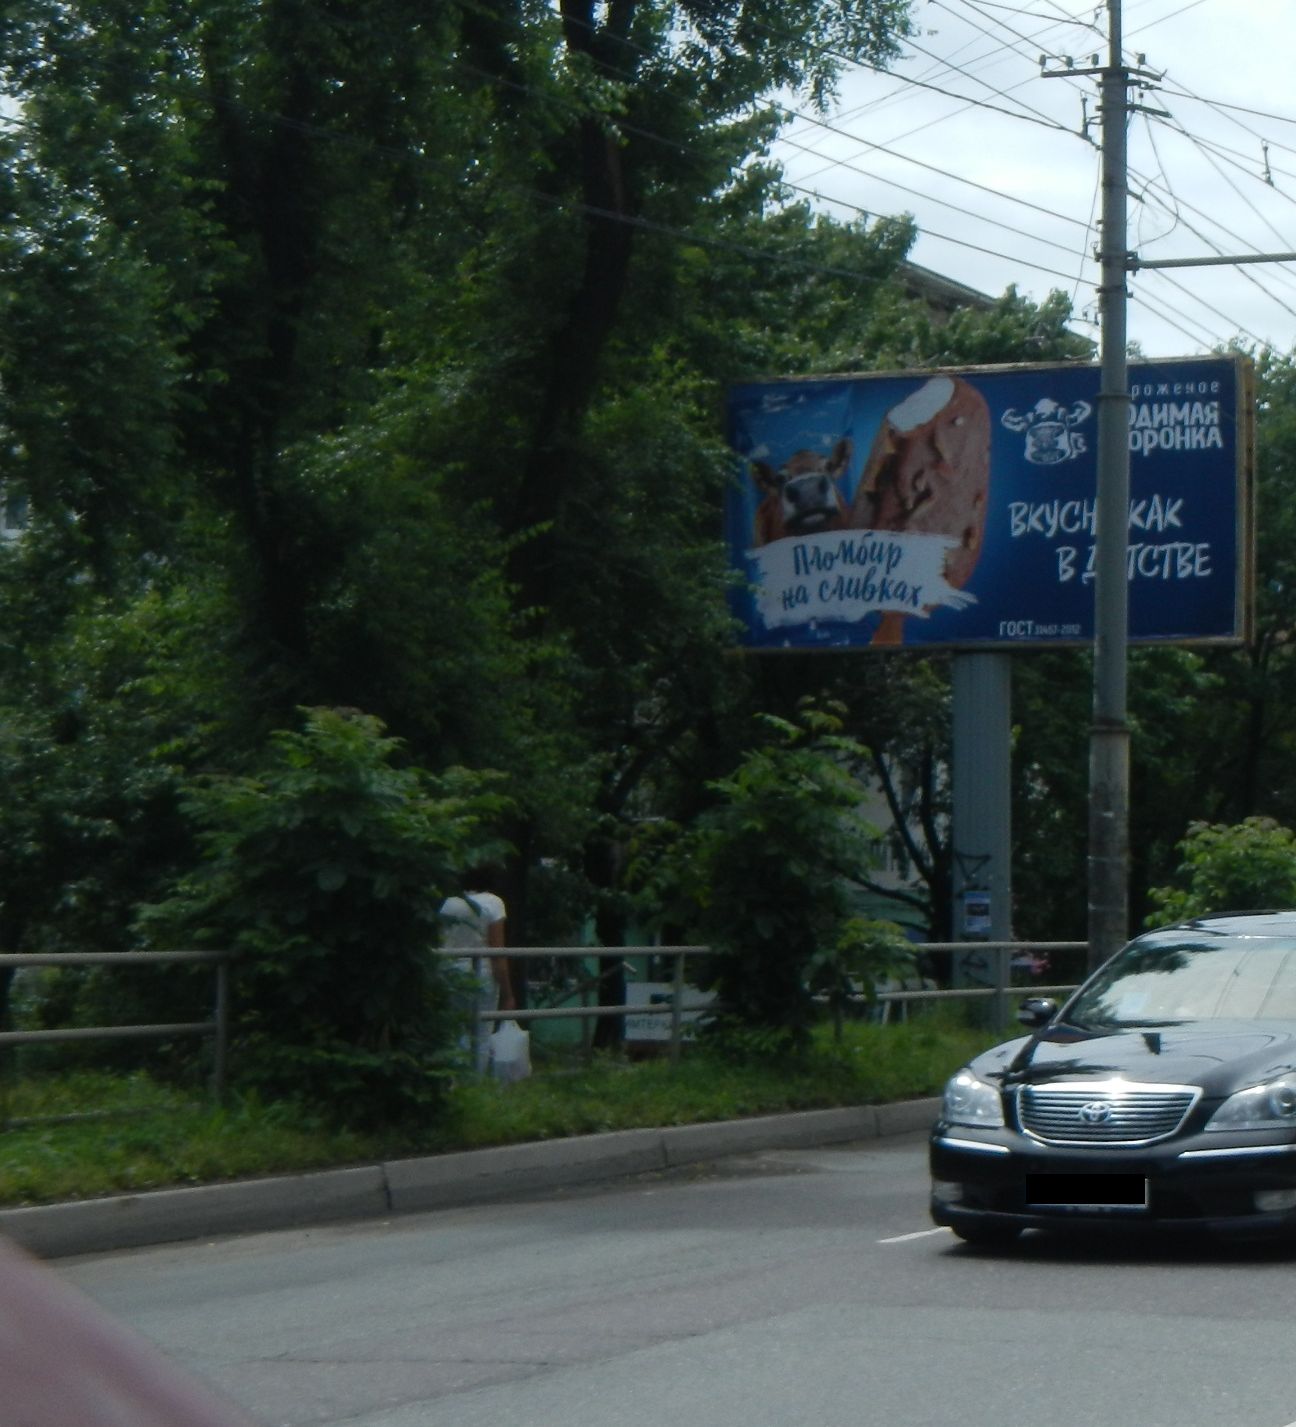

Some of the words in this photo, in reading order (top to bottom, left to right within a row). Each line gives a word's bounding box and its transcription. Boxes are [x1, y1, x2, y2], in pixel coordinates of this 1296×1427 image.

[1131, 381, 1220, 401] роженое
[1128, 425, 1224, 456] ОРОНКА
[1008, 498, 1097, 538] ВКУСН
[1128, 494, 1184, 532] КАК
[792, 532, 902, 575] Пломбир
[1055, 546, 1078, 582] В
[1081, 541, 1212, 584] ДТСТВЕ
[781, 584, 808, 610] на
[819, 566, 922, 607] сливках
[999, 620, 1033, 636] ГОСТ
